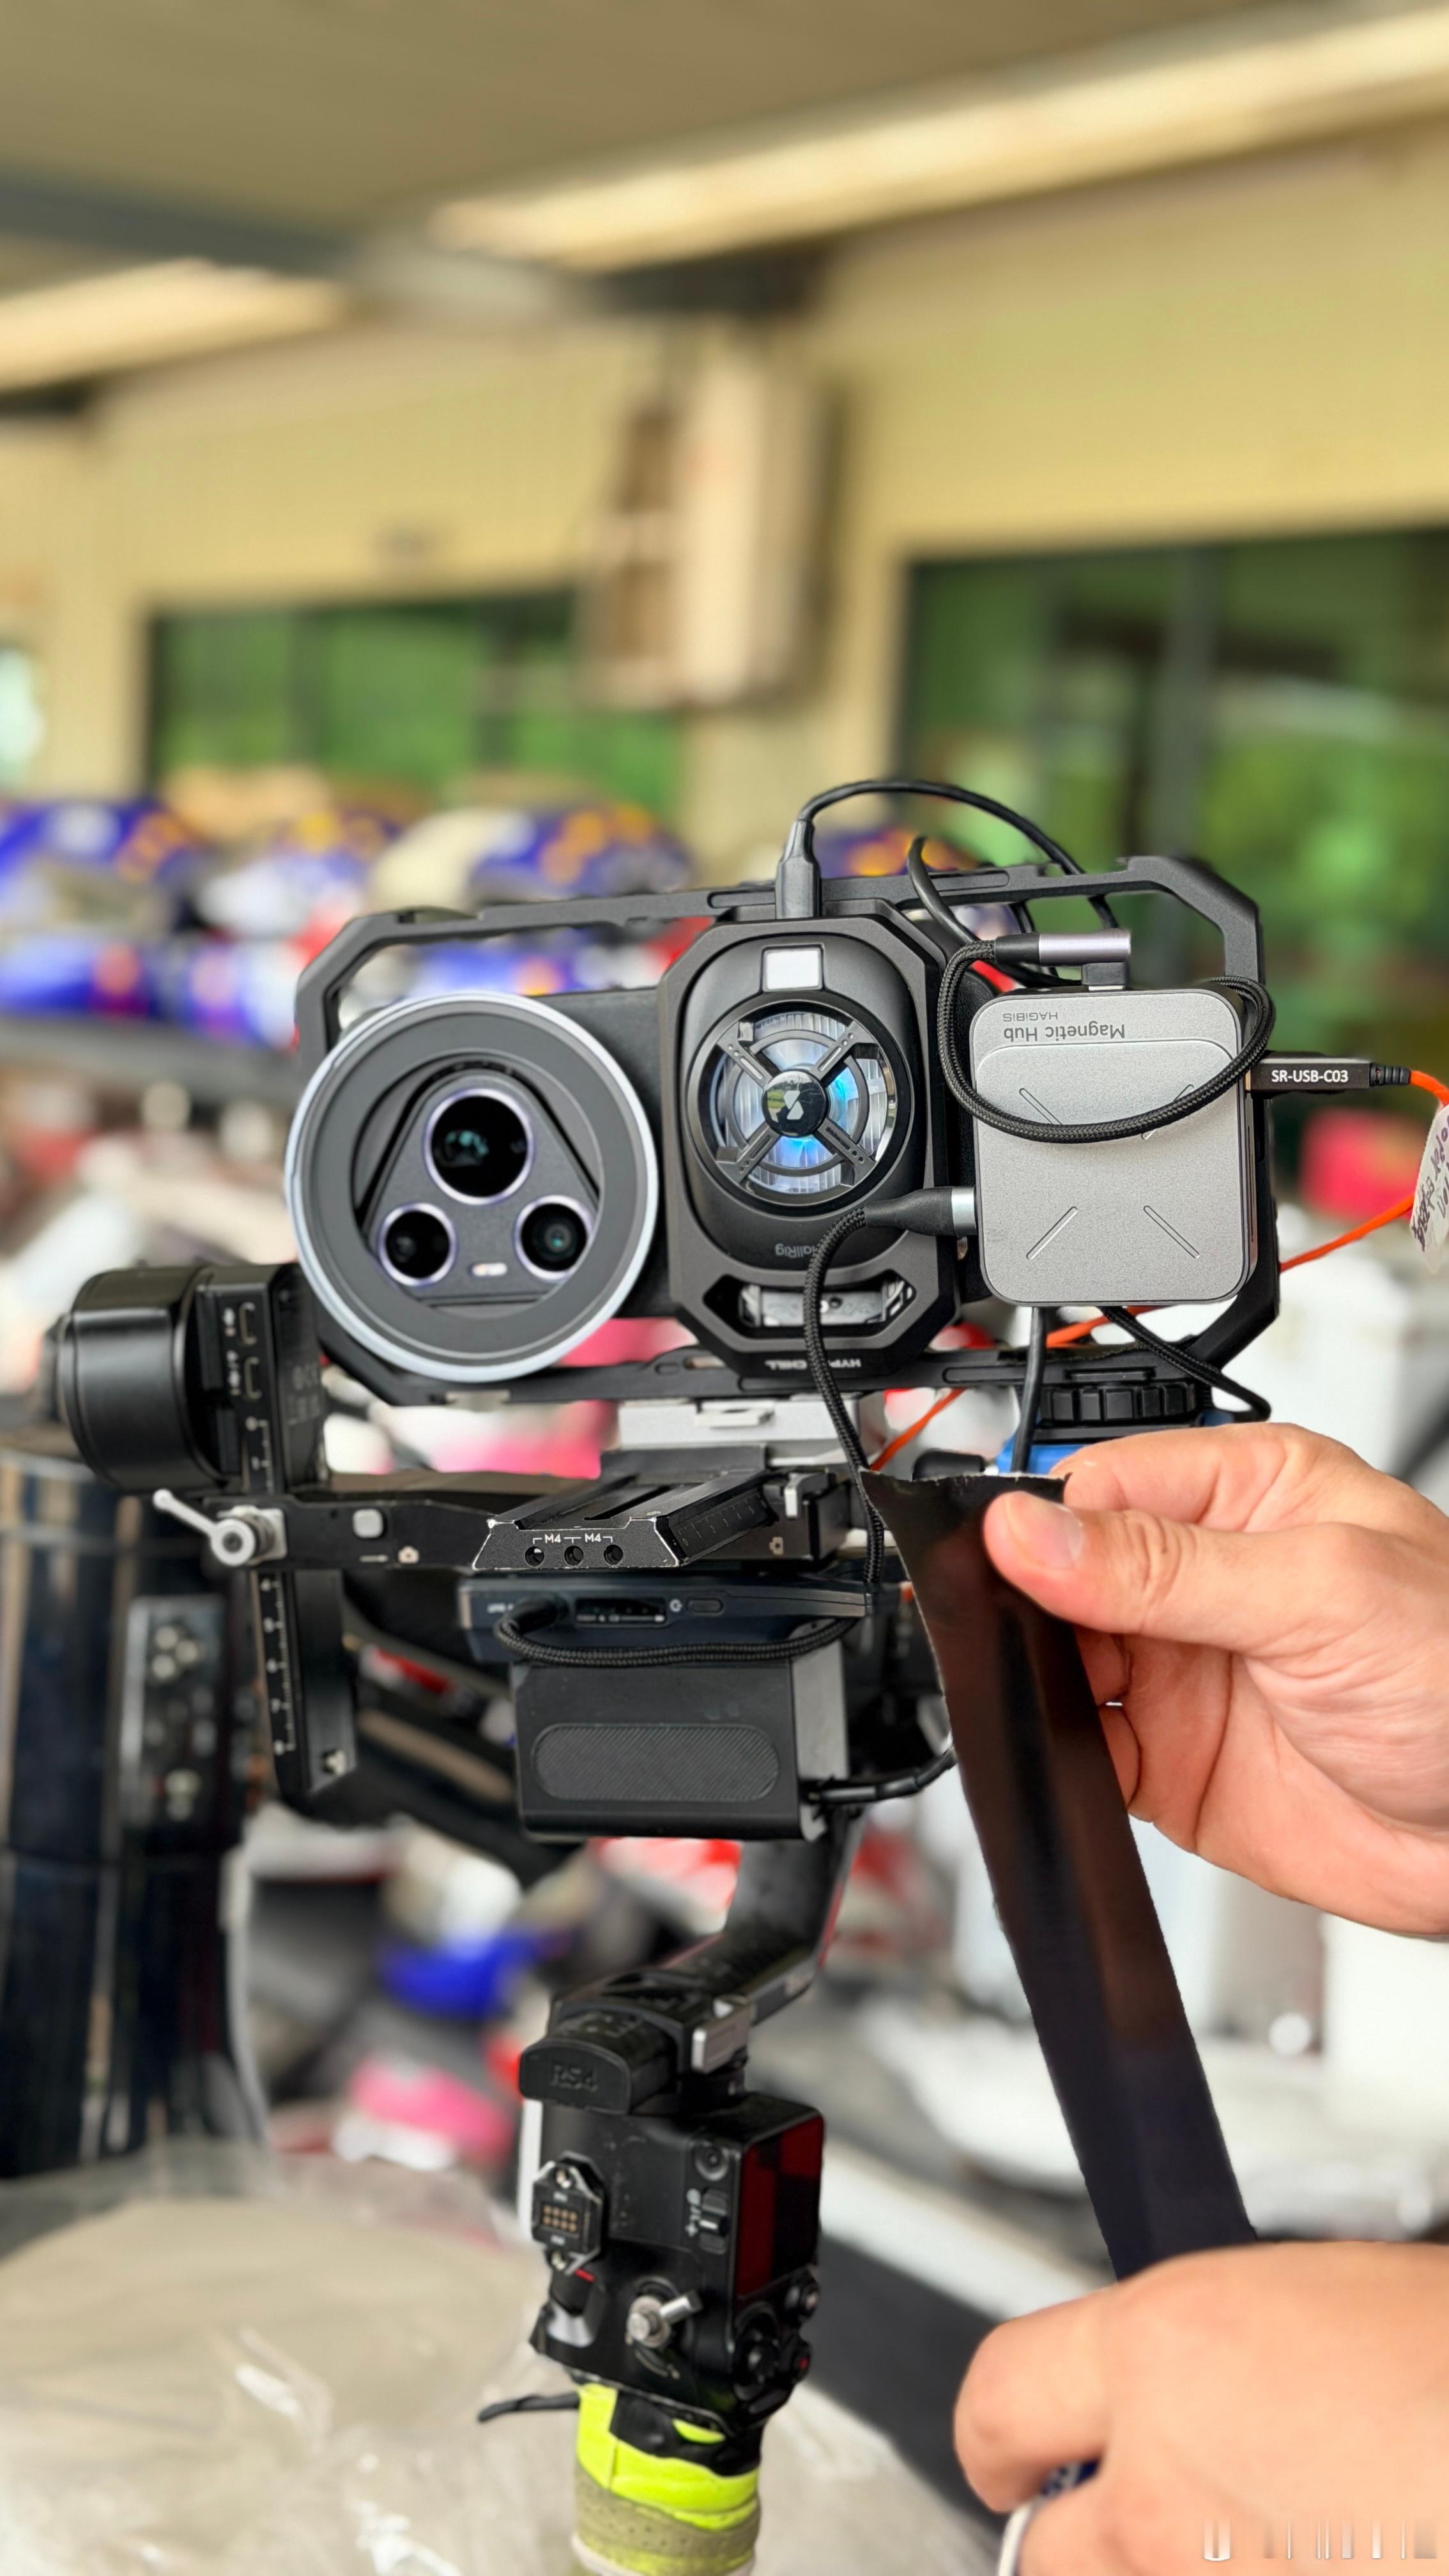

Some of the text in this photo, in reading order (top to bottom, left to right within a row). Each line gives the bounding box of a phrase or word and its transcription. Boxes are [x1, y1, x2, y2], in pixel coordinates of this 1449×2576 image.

[1004, 1021, 1125, 1042] Magnetic Hub
[1271, 1070, 1349, 1083] SR-USB-C03
[544, 1533, 601, 1544] M4 M4
